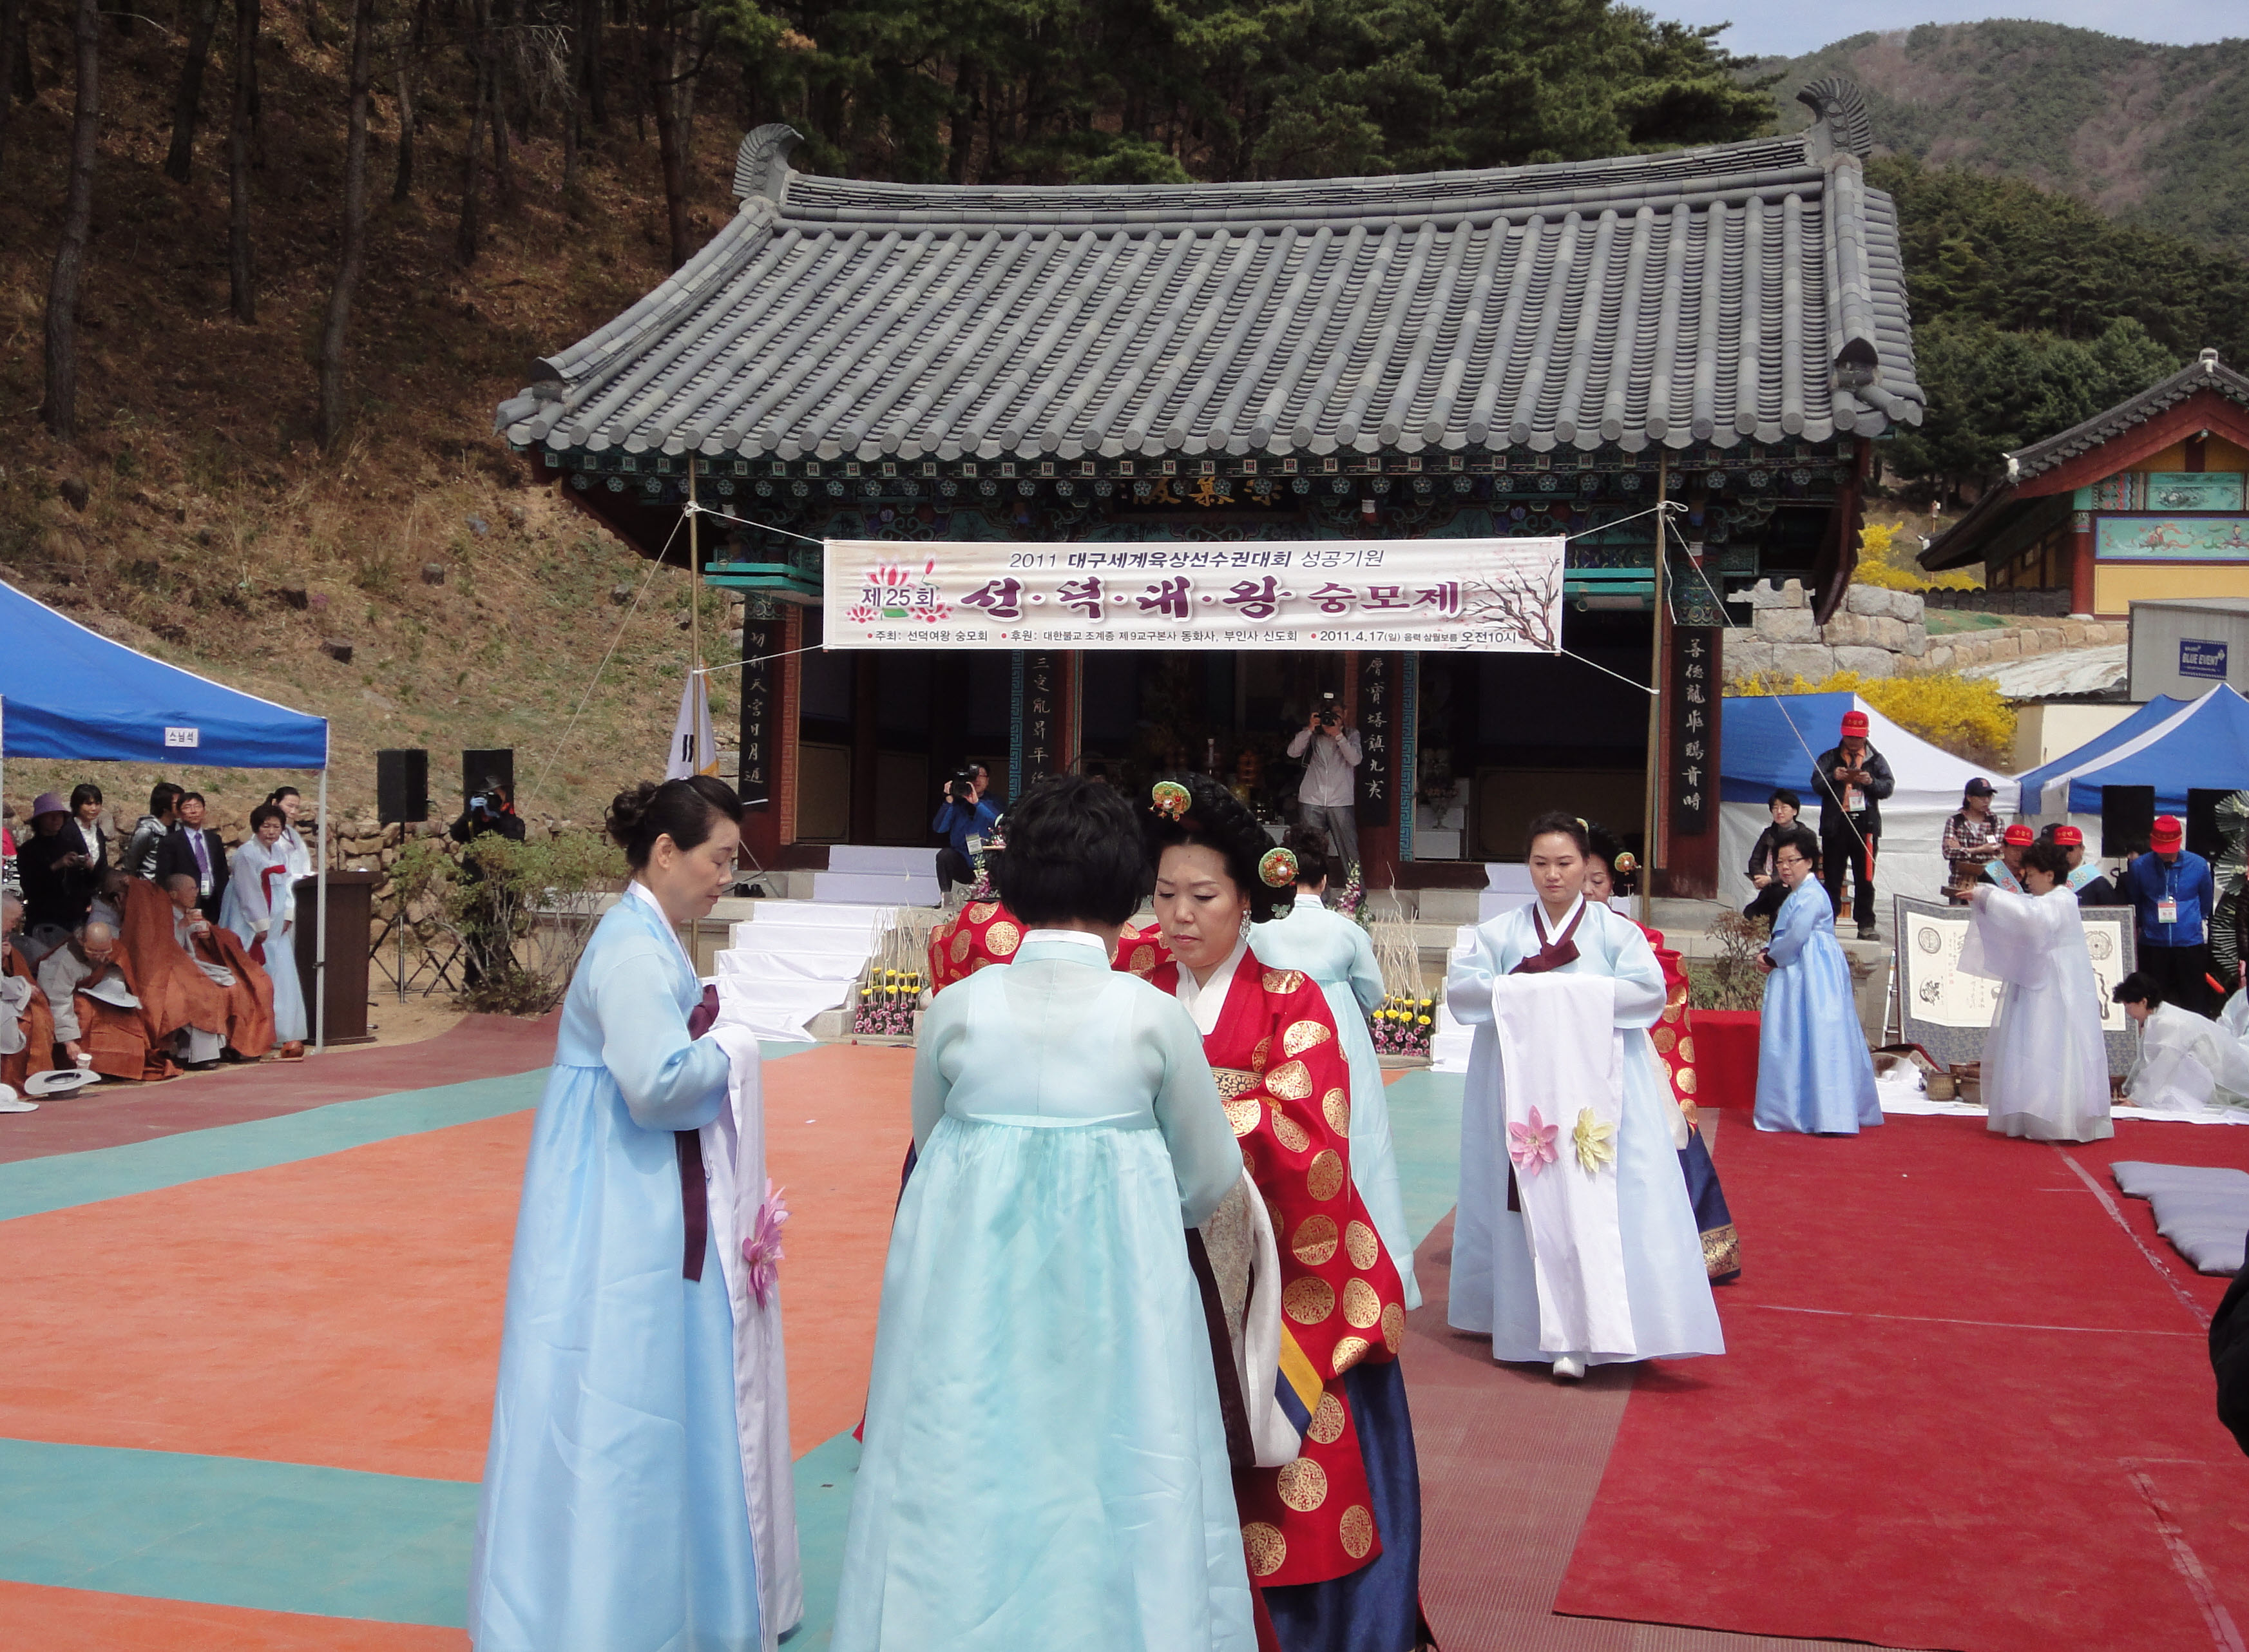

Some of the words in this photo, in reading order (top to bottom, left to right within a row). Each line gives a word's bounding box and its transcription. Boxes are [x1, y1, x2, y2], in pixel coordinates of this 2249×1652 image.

[1010, 553, 1057, 568] 2011
[1067, 551, 1292, 568] 대구세계육상선수권대회
[1301, 550, 1384, 568] 성공기원
[861, 587, 935, 607] 제25회
[1307, 581, 1459, 614] 숭모제
[875, 630, 901, 642] 주최:
[907, 630, 951, 642] 선덕여왕
[955, 630, 988, 642] 숭모회
[1010, 630, 1037, 642] 후원:
[1044, 630, 1082, 642] 대한불교
[1085, 630, 1115, 642] 조계종
[1224, 630, 1258, 642] 부인사
[1263, 630, 1297, 642] 신도회
[1461, 631, 1517, 644] 오전10시
[2182, 653, 2198, 664] BLUE
[2199, 654, 2219, 666] EVENT
[169, 731, 194, 743] 스님석
